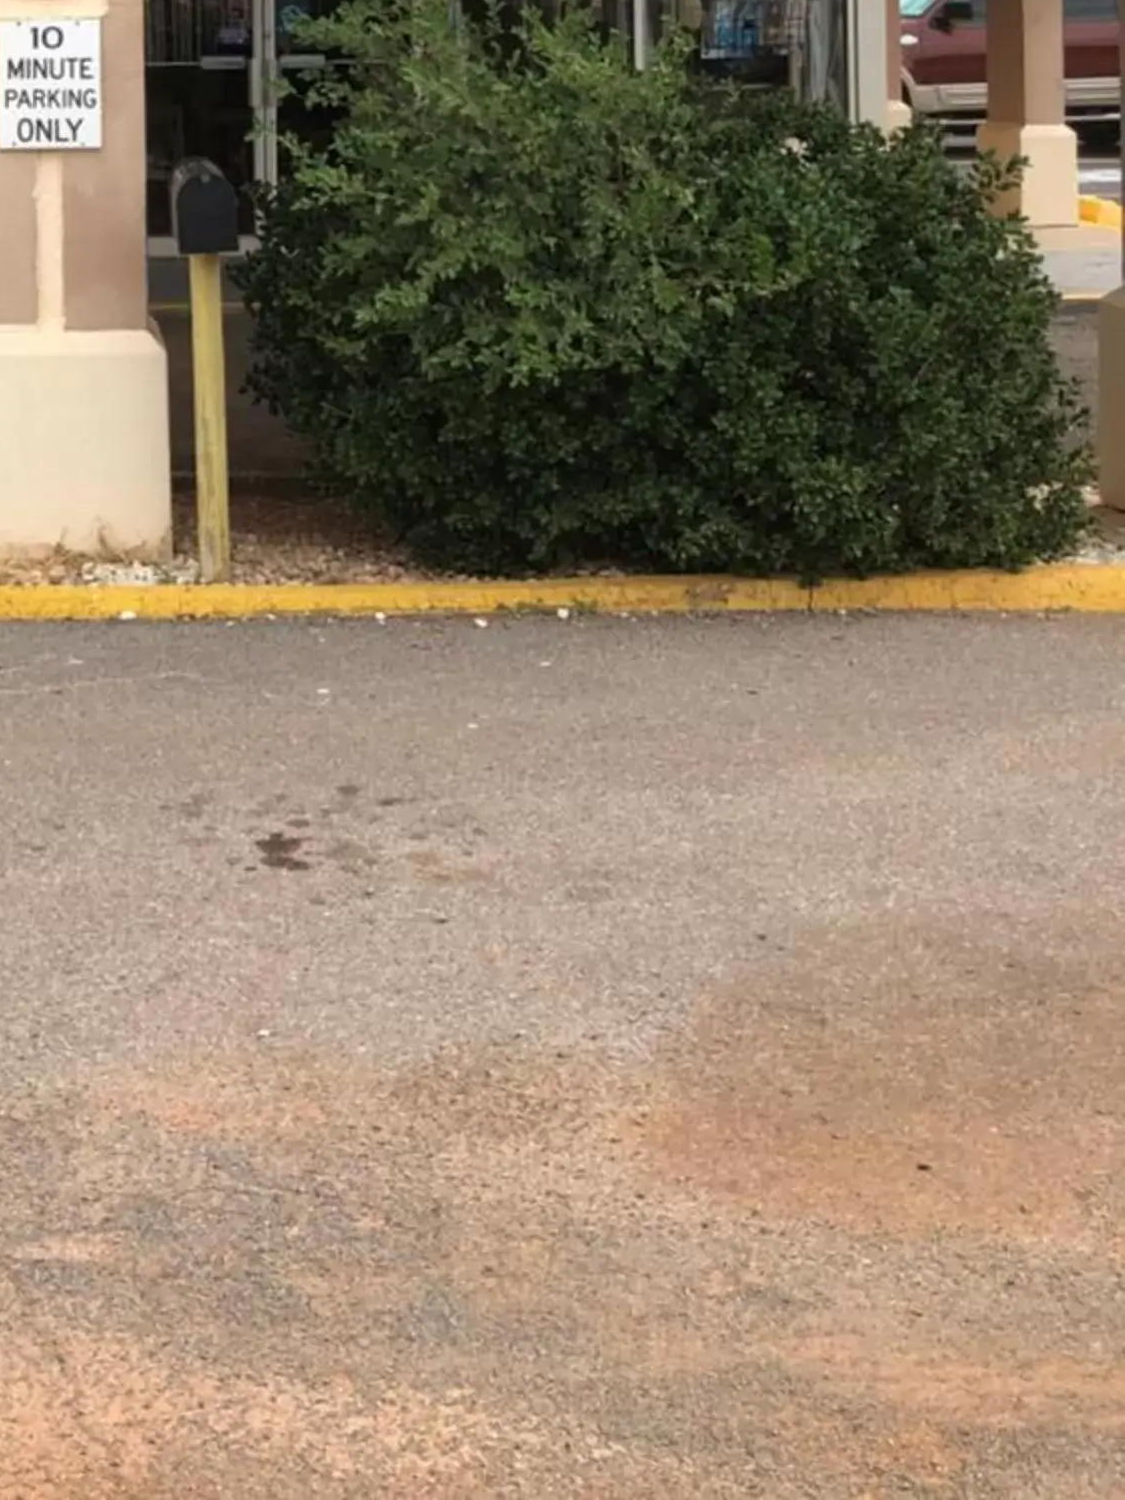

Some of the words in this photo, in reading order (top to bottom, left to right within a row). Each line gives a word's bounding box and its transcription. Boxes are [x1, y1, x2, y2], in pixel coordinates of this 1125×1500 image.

[30, 25, 65, 50] 10
[6, 57, 94, 80] MINUTE
[4, 88, 97, 109] PARKING
[16, 117, 84, 143] ONLY
